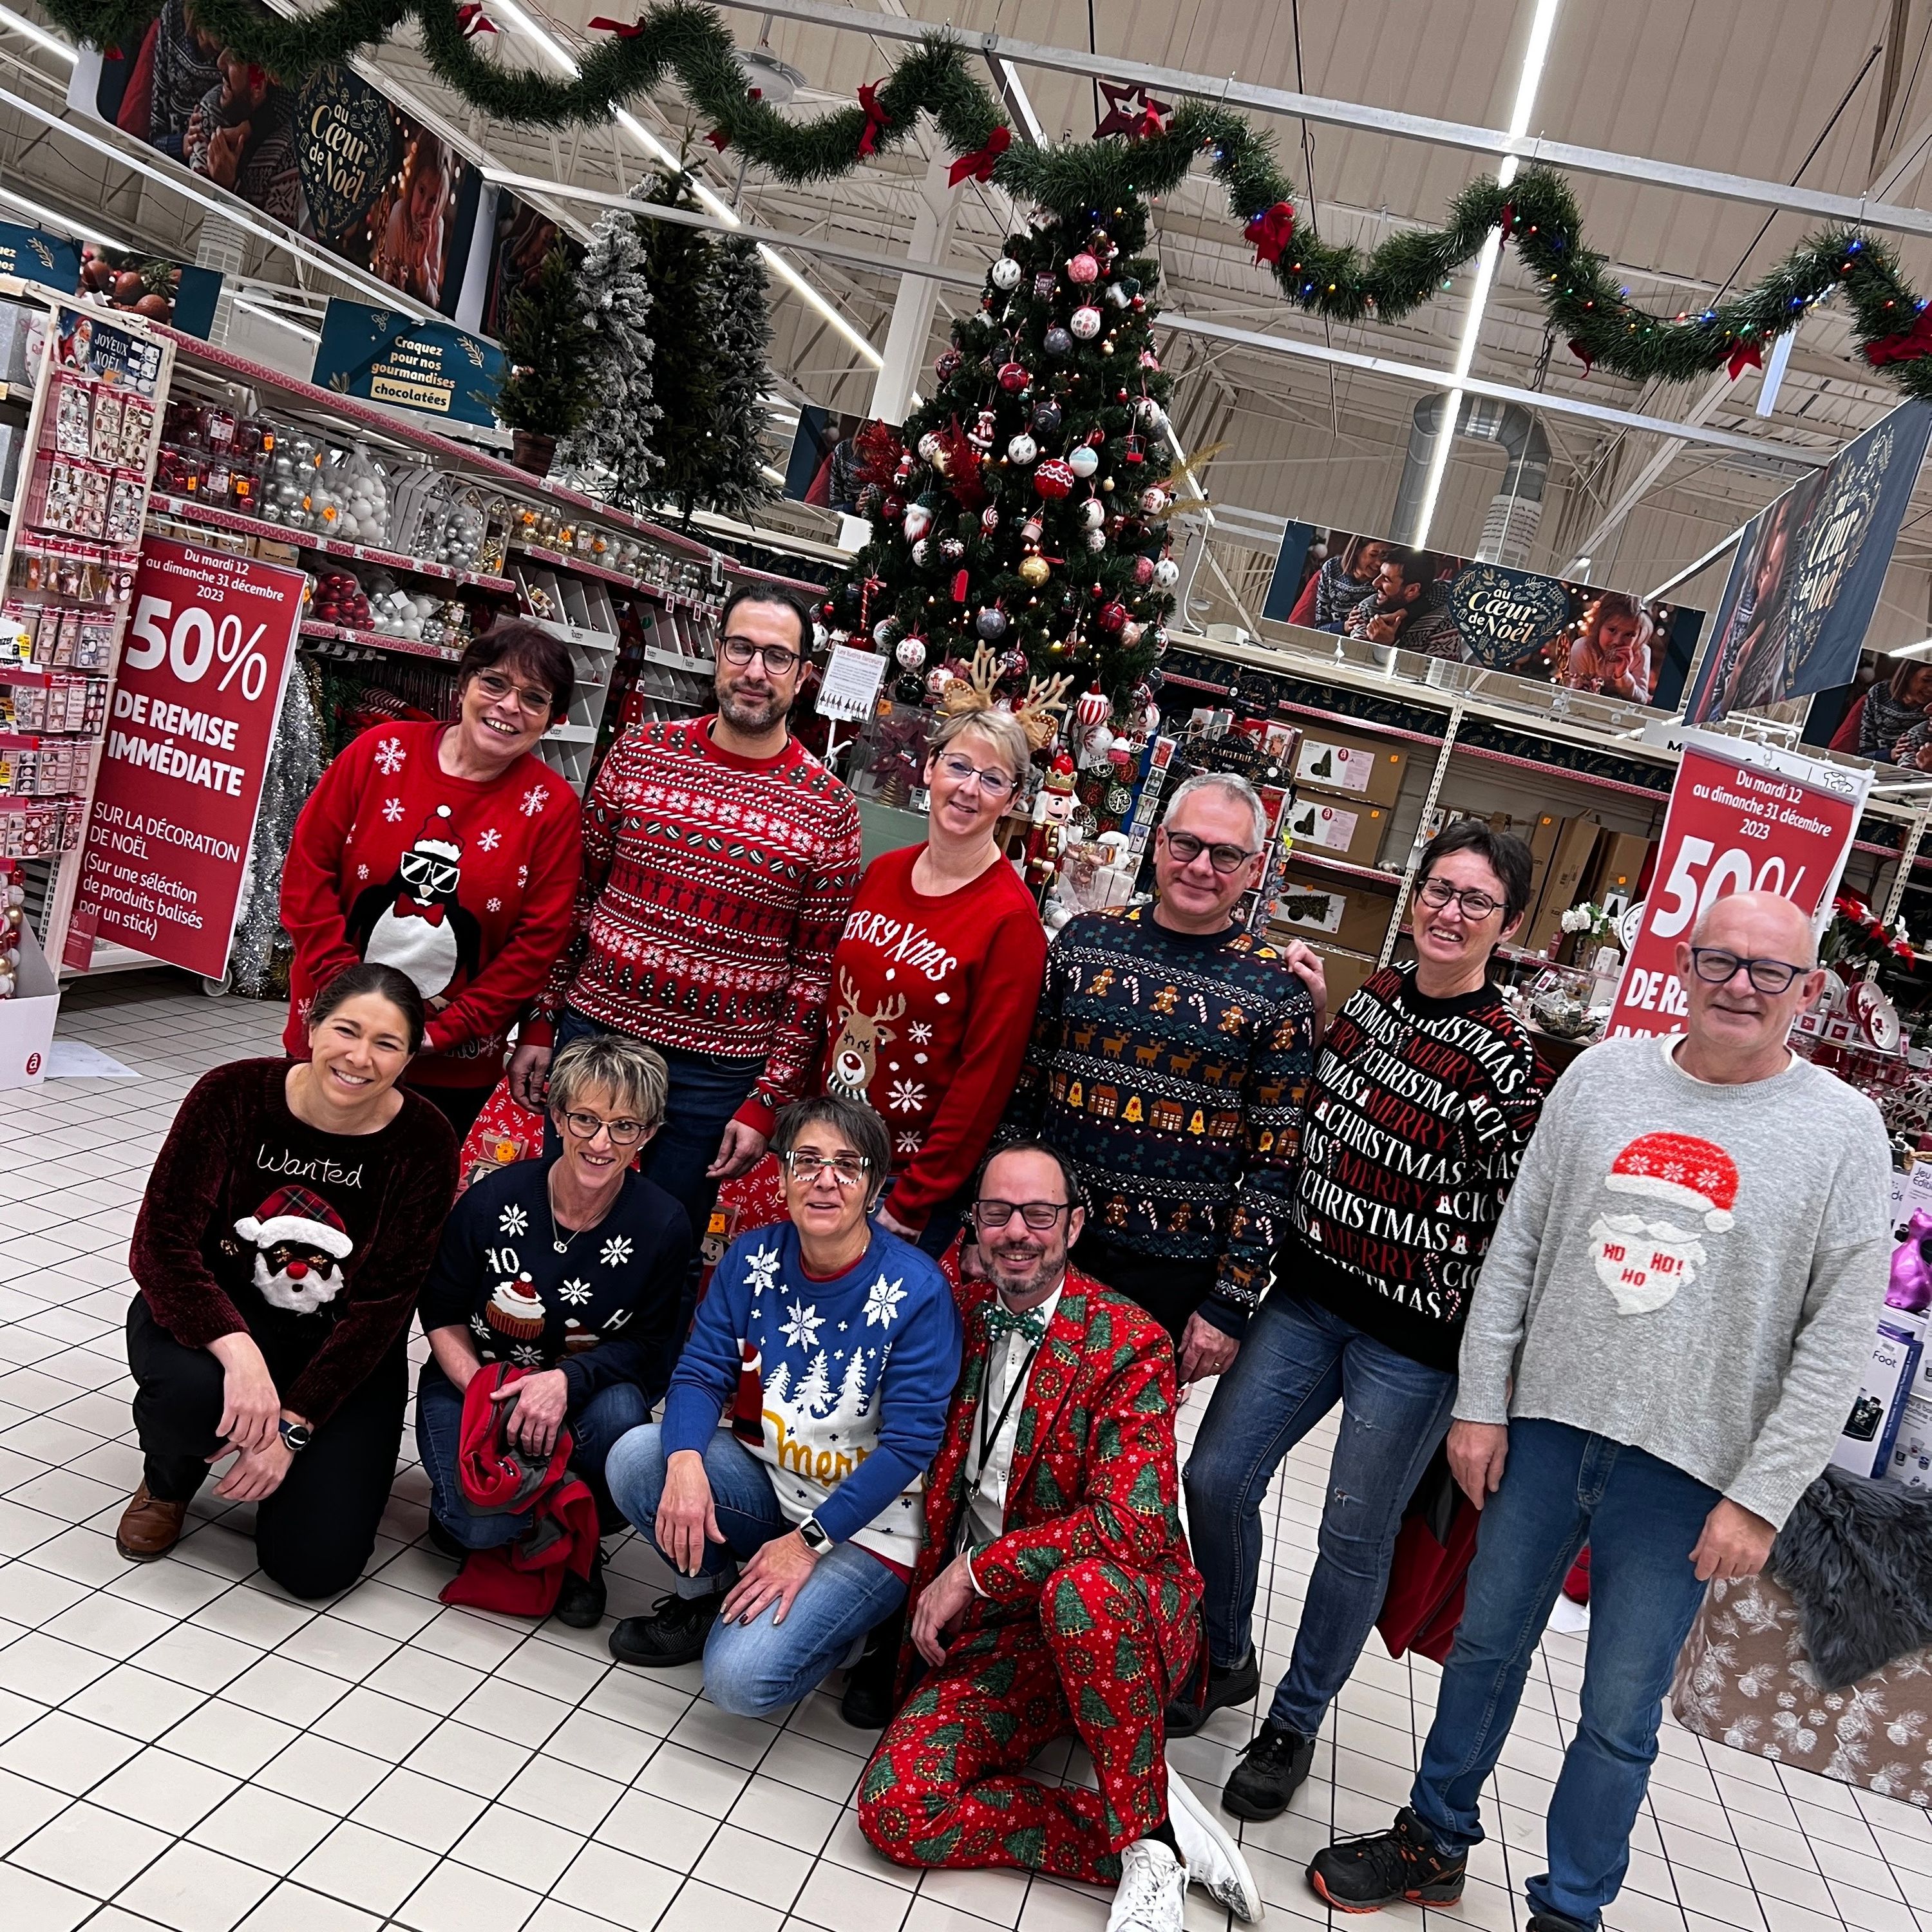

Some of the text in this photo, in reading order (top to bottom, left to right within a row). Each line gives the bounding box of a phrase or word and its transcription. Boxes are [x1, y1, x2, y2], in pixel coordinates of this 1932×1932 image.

[334, 104, 349, 124] au
[311, 104, 368, 165] Cœur
[309, 143, 366, 204] de Noël
[93, 350, 119, 372] NOËL
[95, 333, 129, 356] JOYEUX
[390, 352, 441, 371] pour nos
[395, 336, 443, 356] Craquez
[371, 363, 455, 389] gourmandises
[374, 383, 447, 406] chocolatées
[146, 558, 284, 602] au dimanche 31 décembre
[184, 548, 249, 576] Du mardi 12
[196, 585, 224, 602] 2023
[1468, 591, 1538, 621] Cœur
[1493, 589, 1511, 600] au
[1468, 612, 1536, 644] de Noël
[125, 594, 268, 701] 50%
[114, 688, 239, 752] DE REMISE
[108, 730, 245, 797] IMMÉDIATE
[1211, 746, 1255, 763] CARTERIE
[1736, 770, 1803, 804] Du mardi 12
[1692, 783, 1832, 837] au dimanche 31 décembre
[90, 825, 149, 860] DE NOËL
[93, 802, 240, 863] SUR LA DÉCORATION
[1739, 819, 1771, 840] 2023
[84, 851, 198, 904] (Sur une séléction
[79, 899, 158, 941] par un stick)
[82, 875, 203, 930] de produits balisés
[1624, 968, 1664, 1010] DE
[1401, 1036, 1484, 1091] MERRY
[1364, 1087, 1457, 1151] MERRY
[1325, 1103, 1466, 1184] CHRISTMAS
[257, 1143, 363, 1189] Wanted
[1334, 1150, 1432, 1210] MERRY
[1302, 1169, 1450, 1251] CHRISTMAS
[1324, 1220, 1421, 1280] MERRY
[1602, 1243, 1684, 1276] HO HO!
[1621, 1268, 1646, 1287] HO
[1872, 1350, 1897, 1368] Foot
